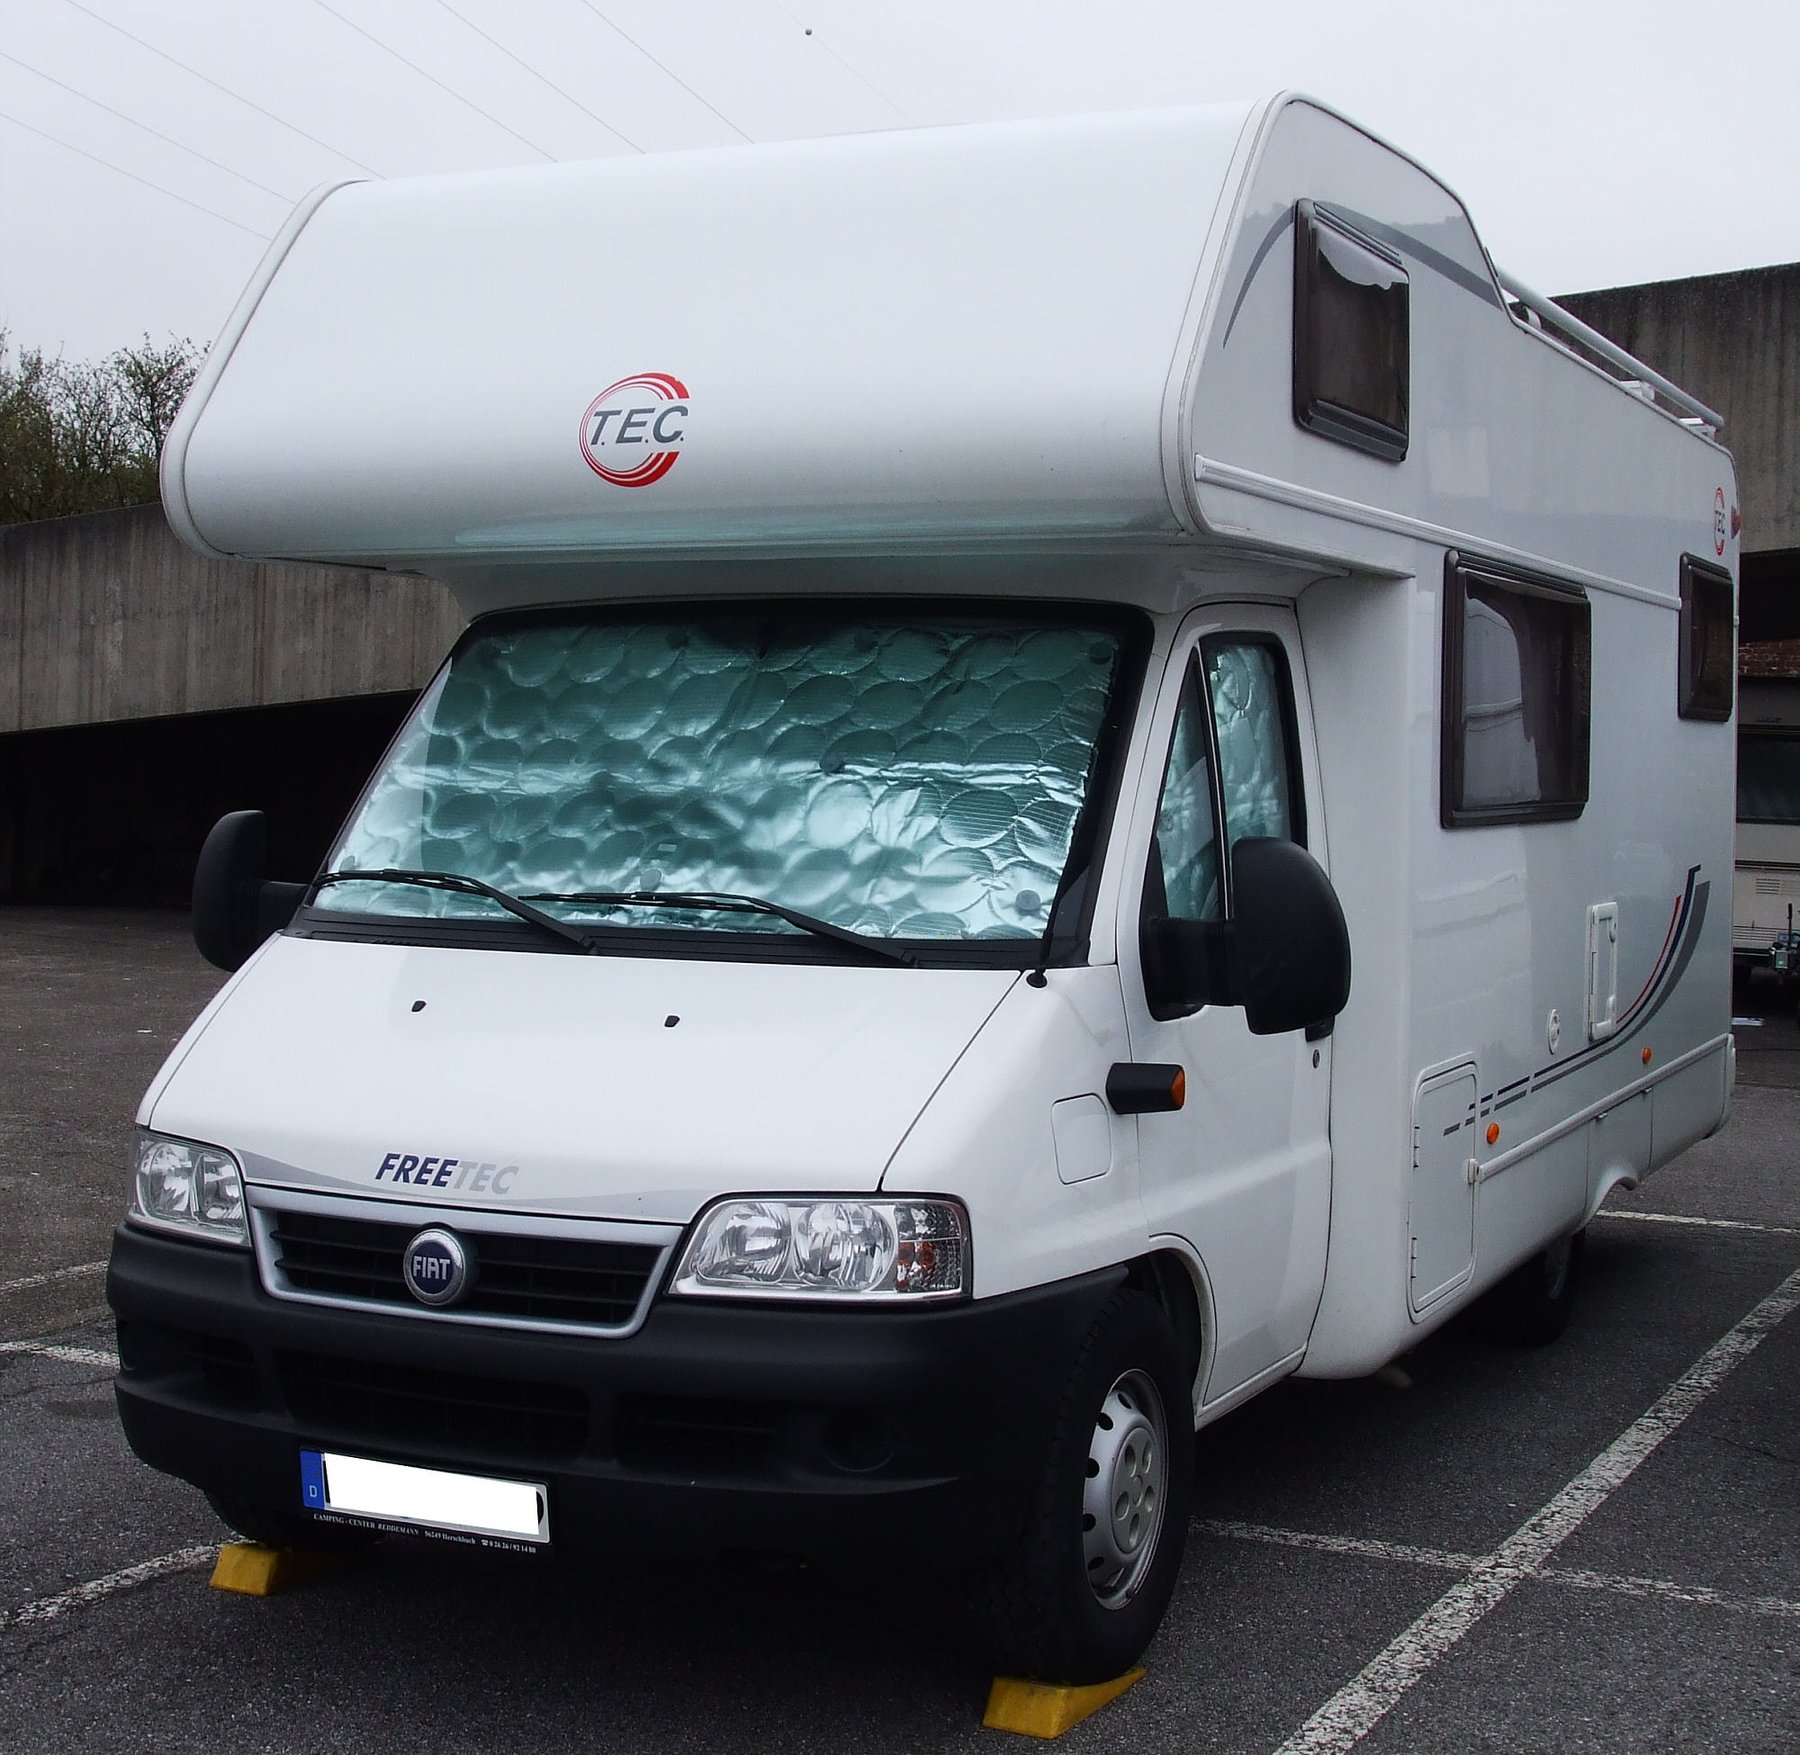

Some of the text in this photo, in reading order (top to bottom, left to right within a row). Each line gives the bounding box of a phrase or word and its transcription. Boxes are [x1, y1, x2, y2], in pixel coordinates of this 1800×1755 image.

[375, 1152, 519, 1195] FREETEC
[413, 1255, 450, 1280] FIAT
[309, 1485, 318, 1498] D
